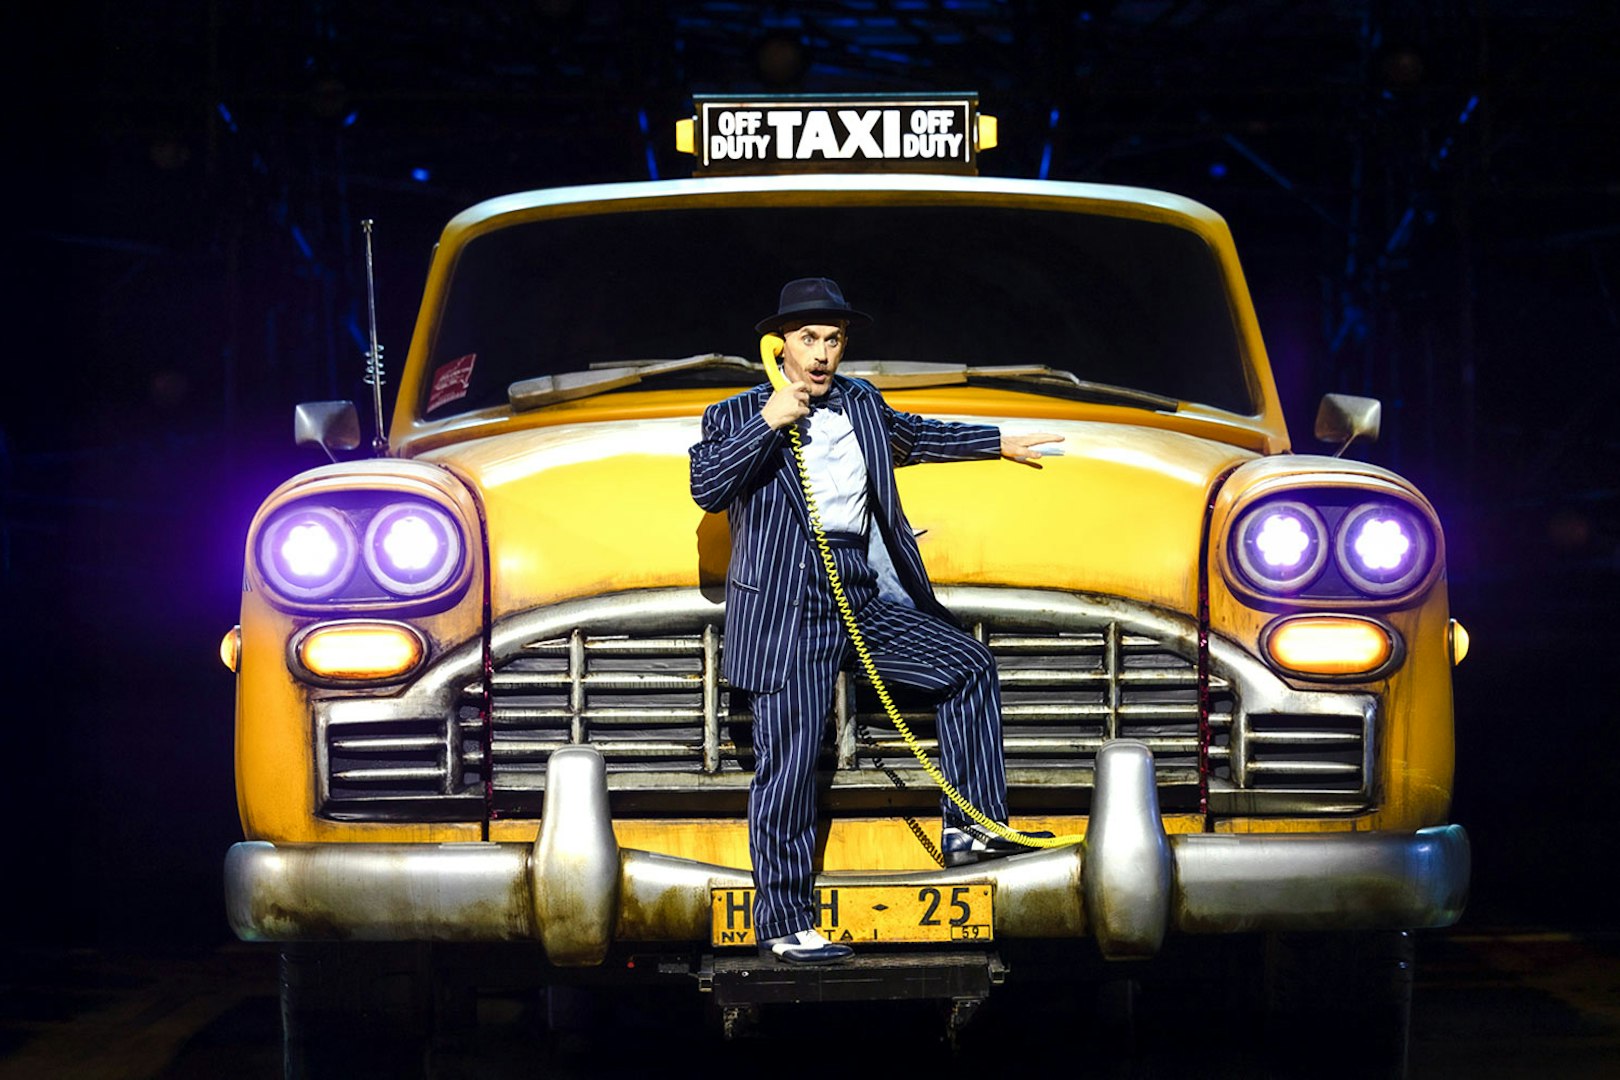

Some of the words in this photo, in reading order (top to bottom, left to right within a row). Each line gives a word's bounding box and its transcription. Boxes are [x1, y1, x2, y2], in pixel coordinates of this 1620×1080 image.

[719, 111, 762, 135] OFF
[910, 110, 954, 134] OFF
[767, 110, 900, 159] TAXI
[903, 133, 963, 158] DUTY
[711, 135, 771, 159] DUTY
[918, 887, 970, 926] 25
[962, 927, 979, 939] 59
